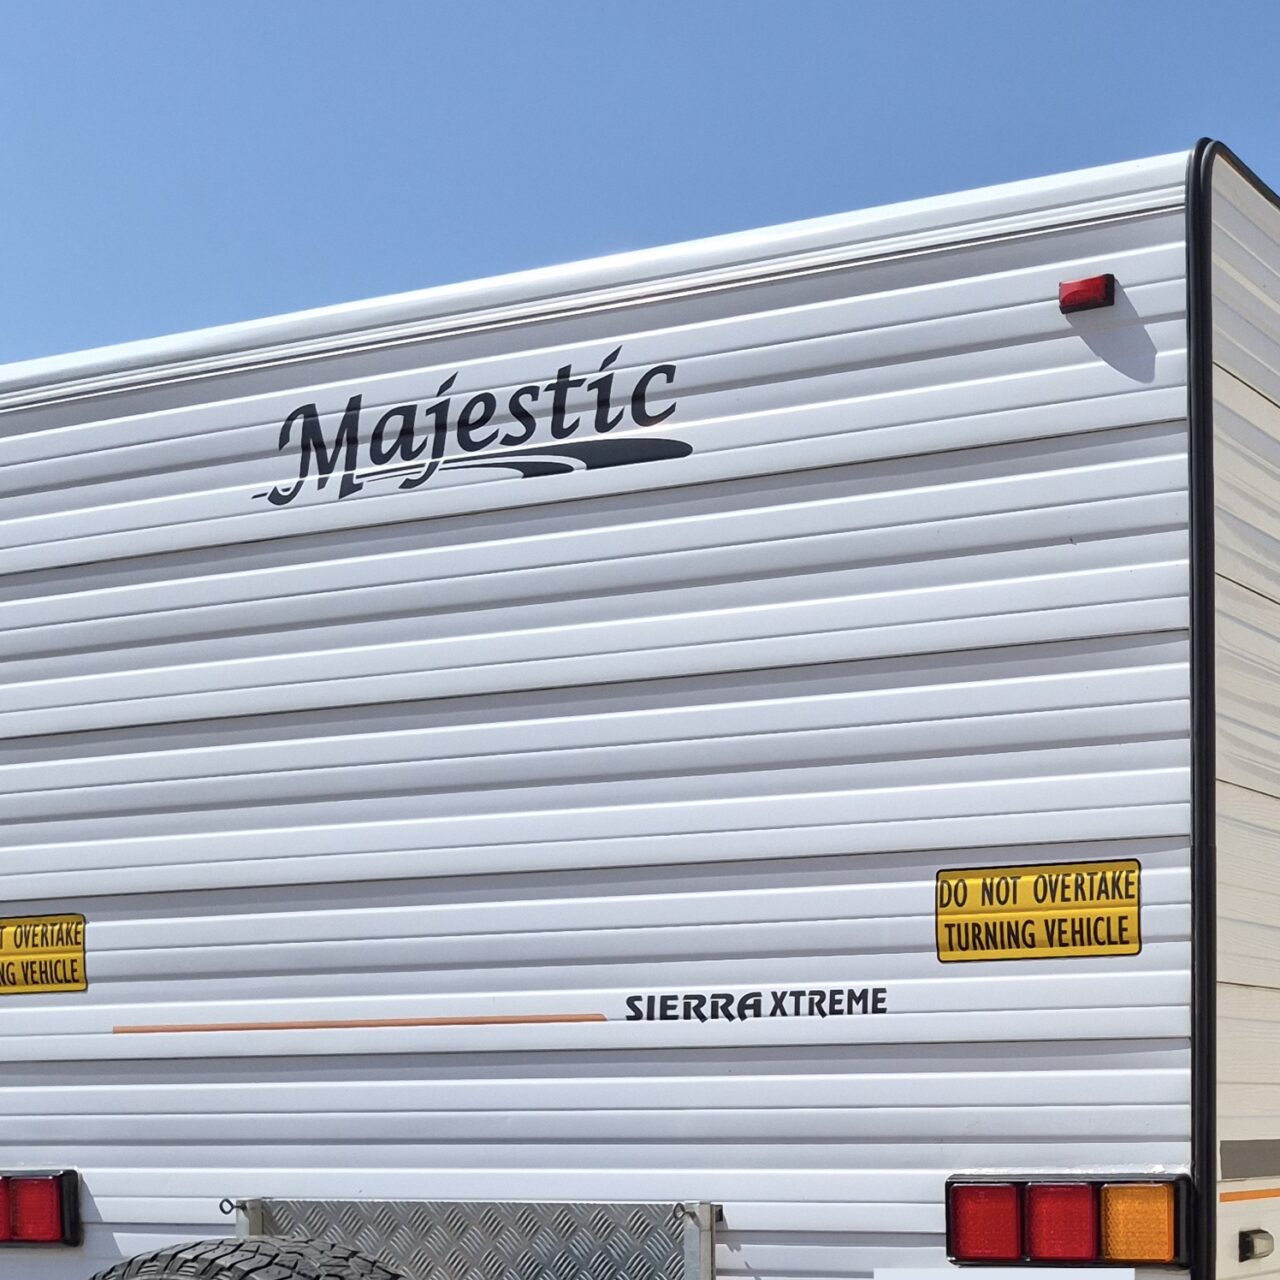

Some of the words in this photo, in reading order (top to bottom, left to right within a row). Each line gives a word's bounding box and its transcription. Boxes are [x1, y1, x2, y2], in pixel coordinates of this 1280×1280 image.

[262, 344, 678, 506] Majestic
[939, 878, 968, 909] DO
[981, 875, 1022, 906] NOT
[1033, 869, 1136, 904] OVERTAKE
[13, 920, 83, 950] OVERTAKE
[944, 919, 1036, 952] TURNING
[1044, 915, 1130, 948] VEHICLE
[21, 958, 80, 986] VEHICLE
[625, 991, 763, 1023] SIERRA
[769, 987, 888, 1019] XTREME
